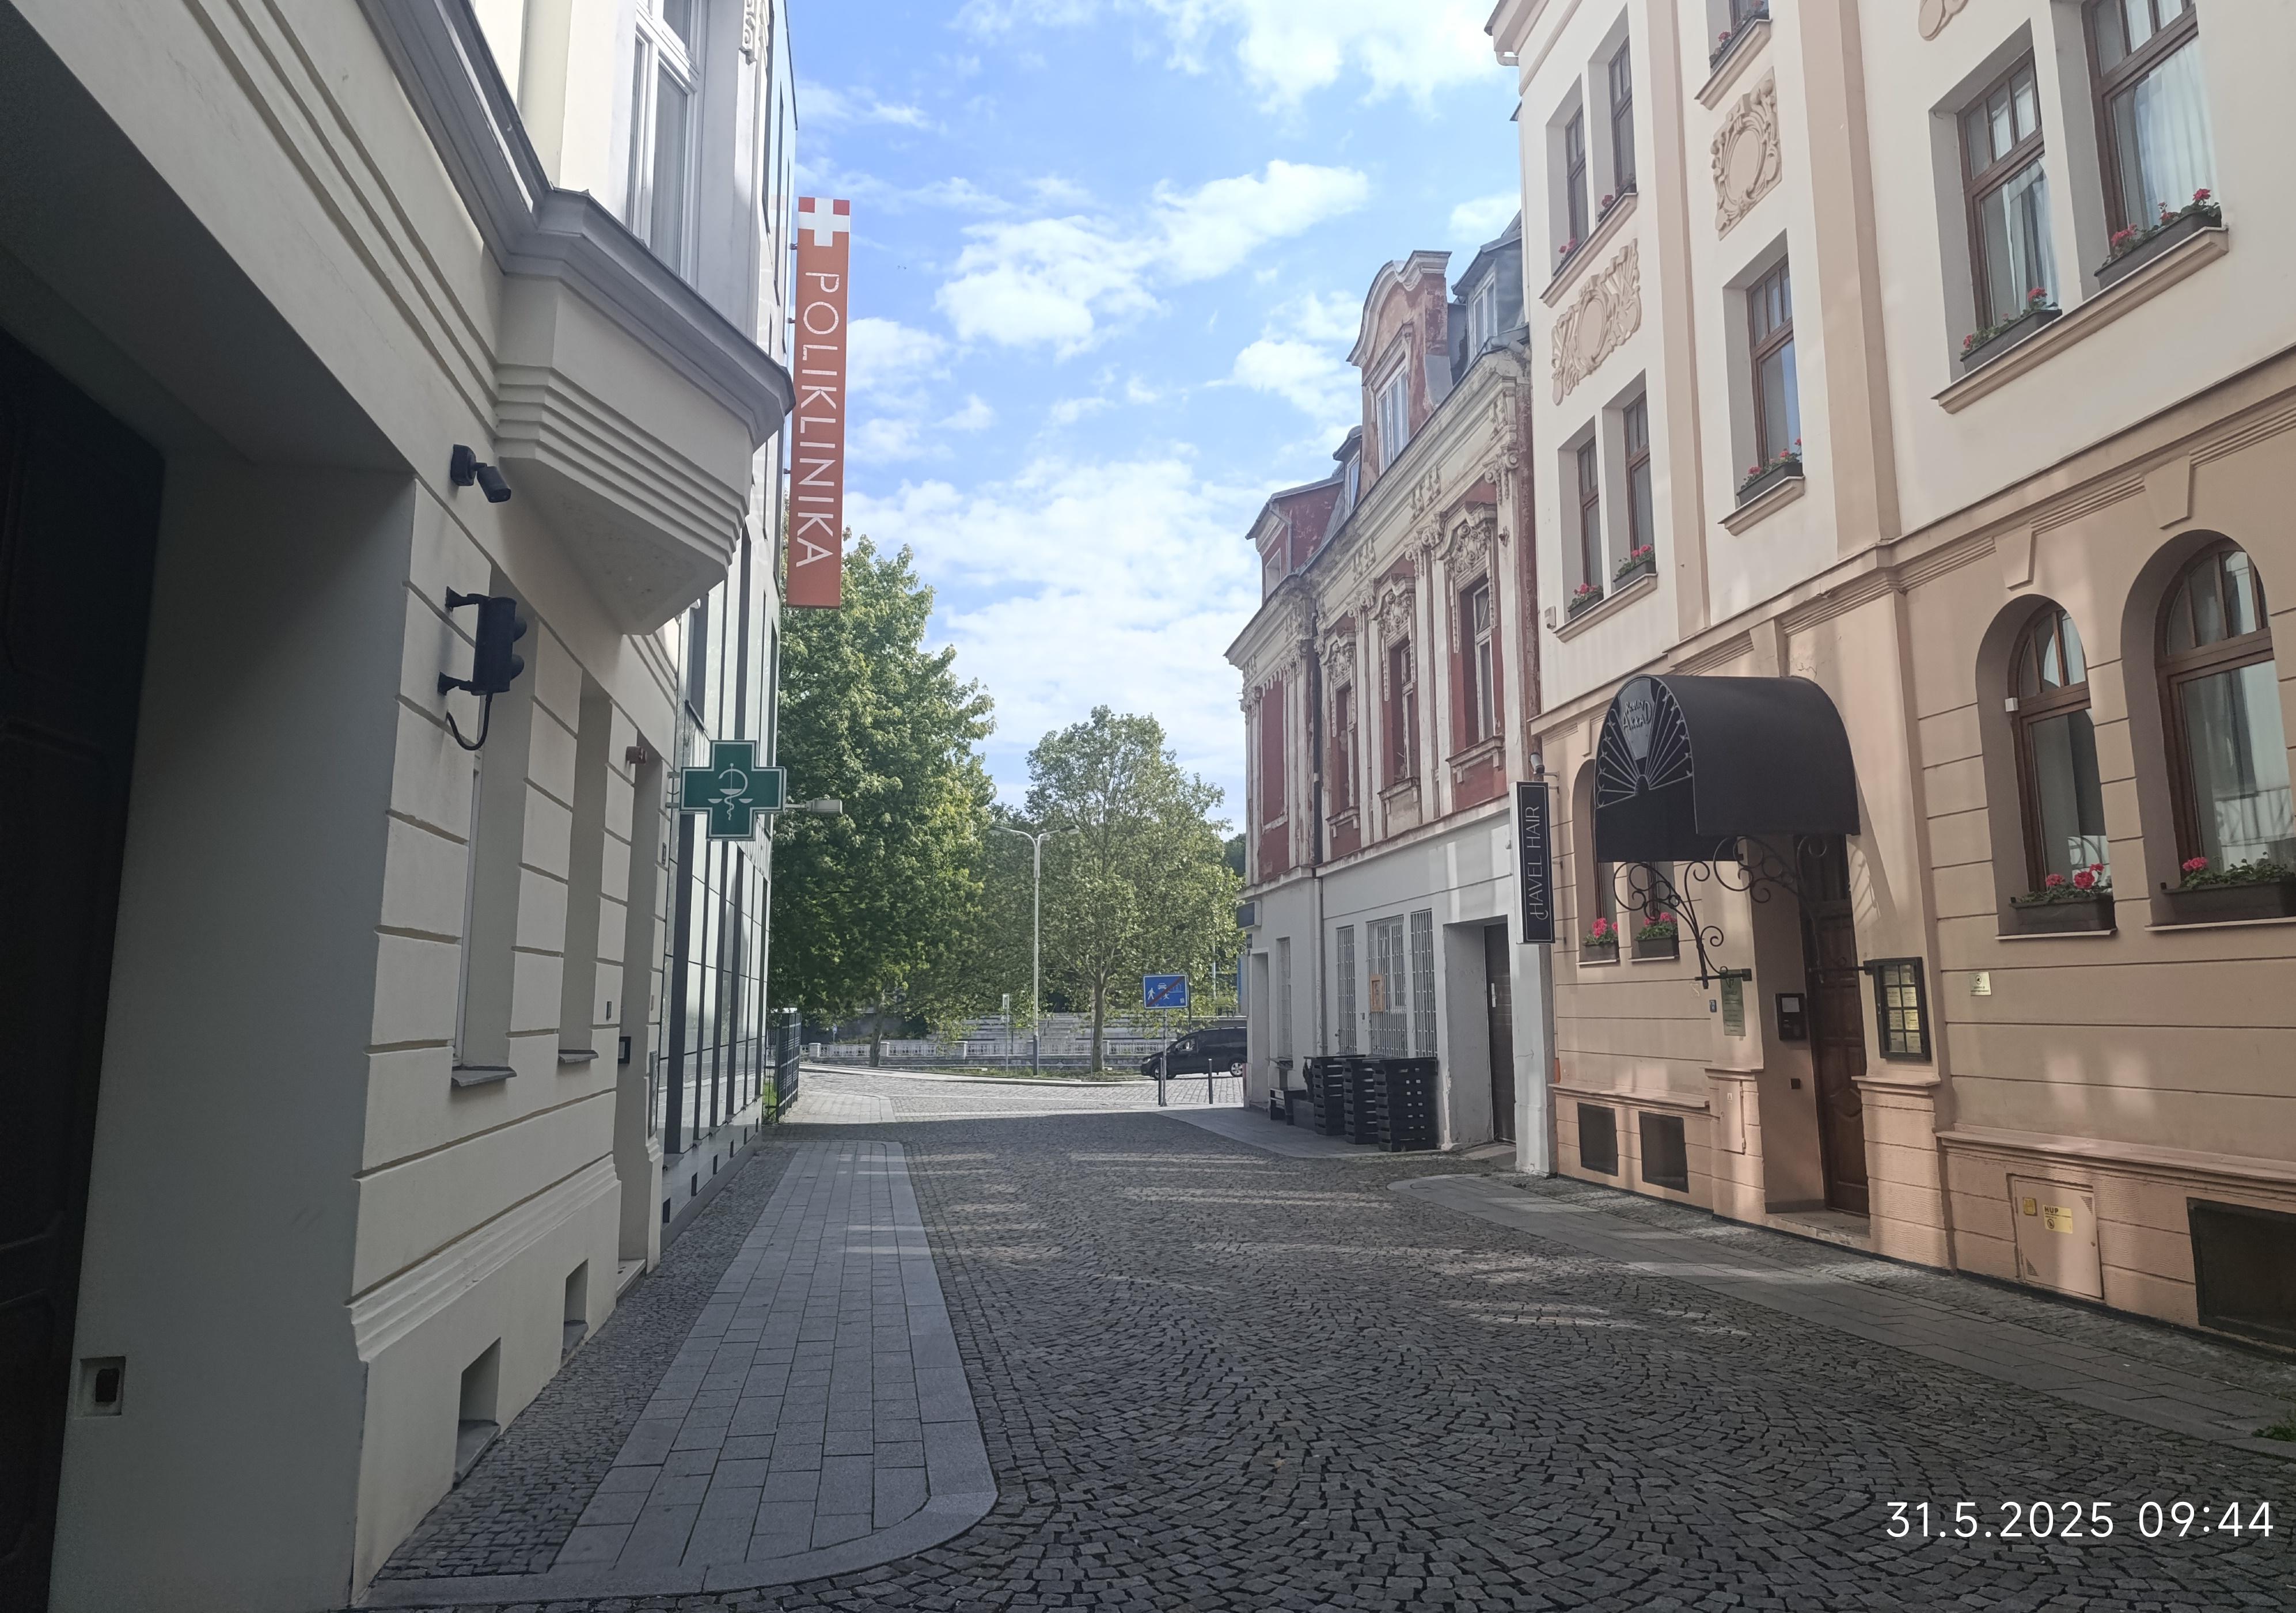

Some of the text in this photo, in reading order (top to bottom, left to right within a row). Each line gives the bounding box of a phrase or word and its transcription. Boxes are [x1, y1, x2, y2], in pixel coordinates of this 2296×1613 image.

[796, 272, 840, 567] POLIKLINIKA
[1525, 806, 1549, 920] HAVEL HAIR
